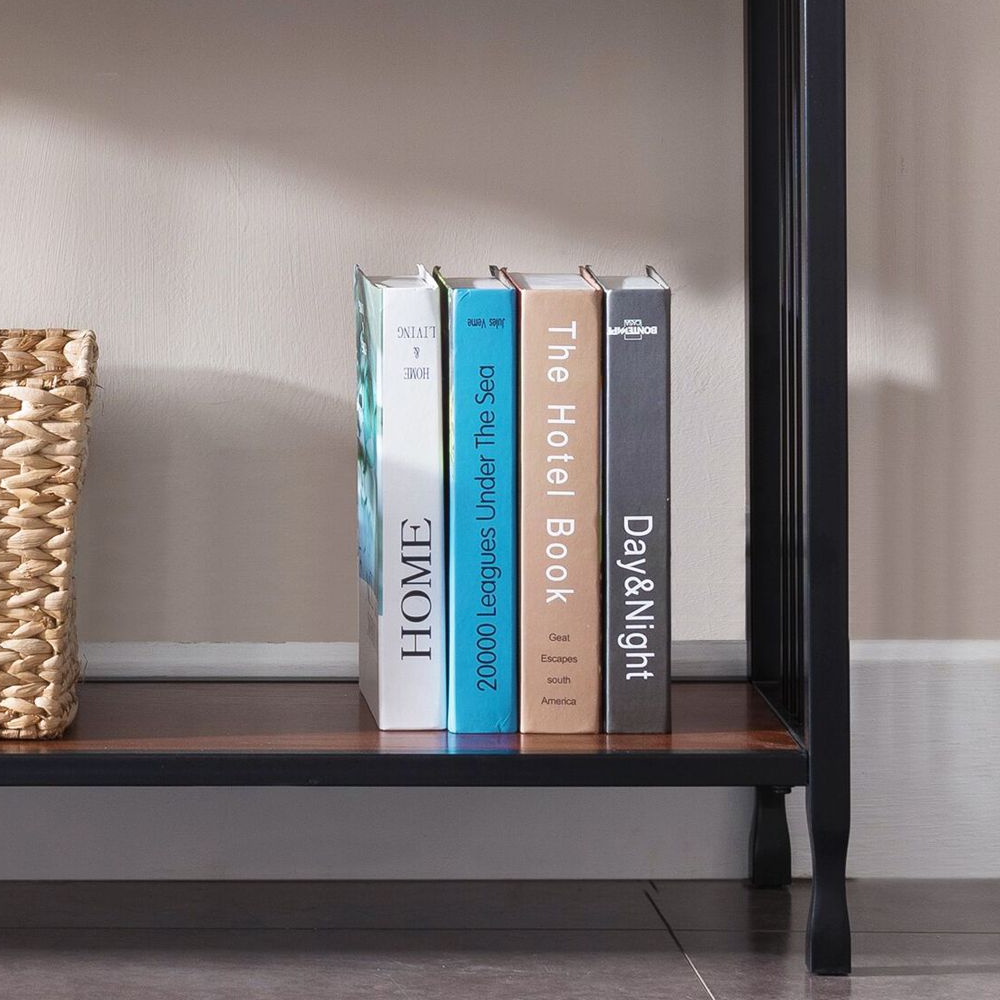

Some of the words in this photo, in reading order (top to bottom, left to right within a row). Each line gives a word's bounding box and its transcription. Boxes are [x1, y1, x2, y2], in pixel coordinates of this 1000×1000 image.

[397, 325, 437, 339] LIVING
[488, 317, 506, 329] Jules
[413, 346, 421, 359] &
[547, 320, 577, 384] The
[403, 367, 430, 380] HOME
[474, 365, 495, 404] Sea
[474, 410, 495, 449] The
[546, 404, 576, 496] Hotel
[475, 453, 496, 521] Under
[476, 526, 502, 617] Leagues
[545, 518, 575, 604] Book
[400, 517, 432, 661] HOME
[616, 515, 656, 681] Day&Night
[548, 632, 571, 643] Geat
[476, 623, 497, 692] 20000
[540, 653, 578, 665] Escapes
[546, 675, 571, 685] south
[540, 696, 577, 706] America
